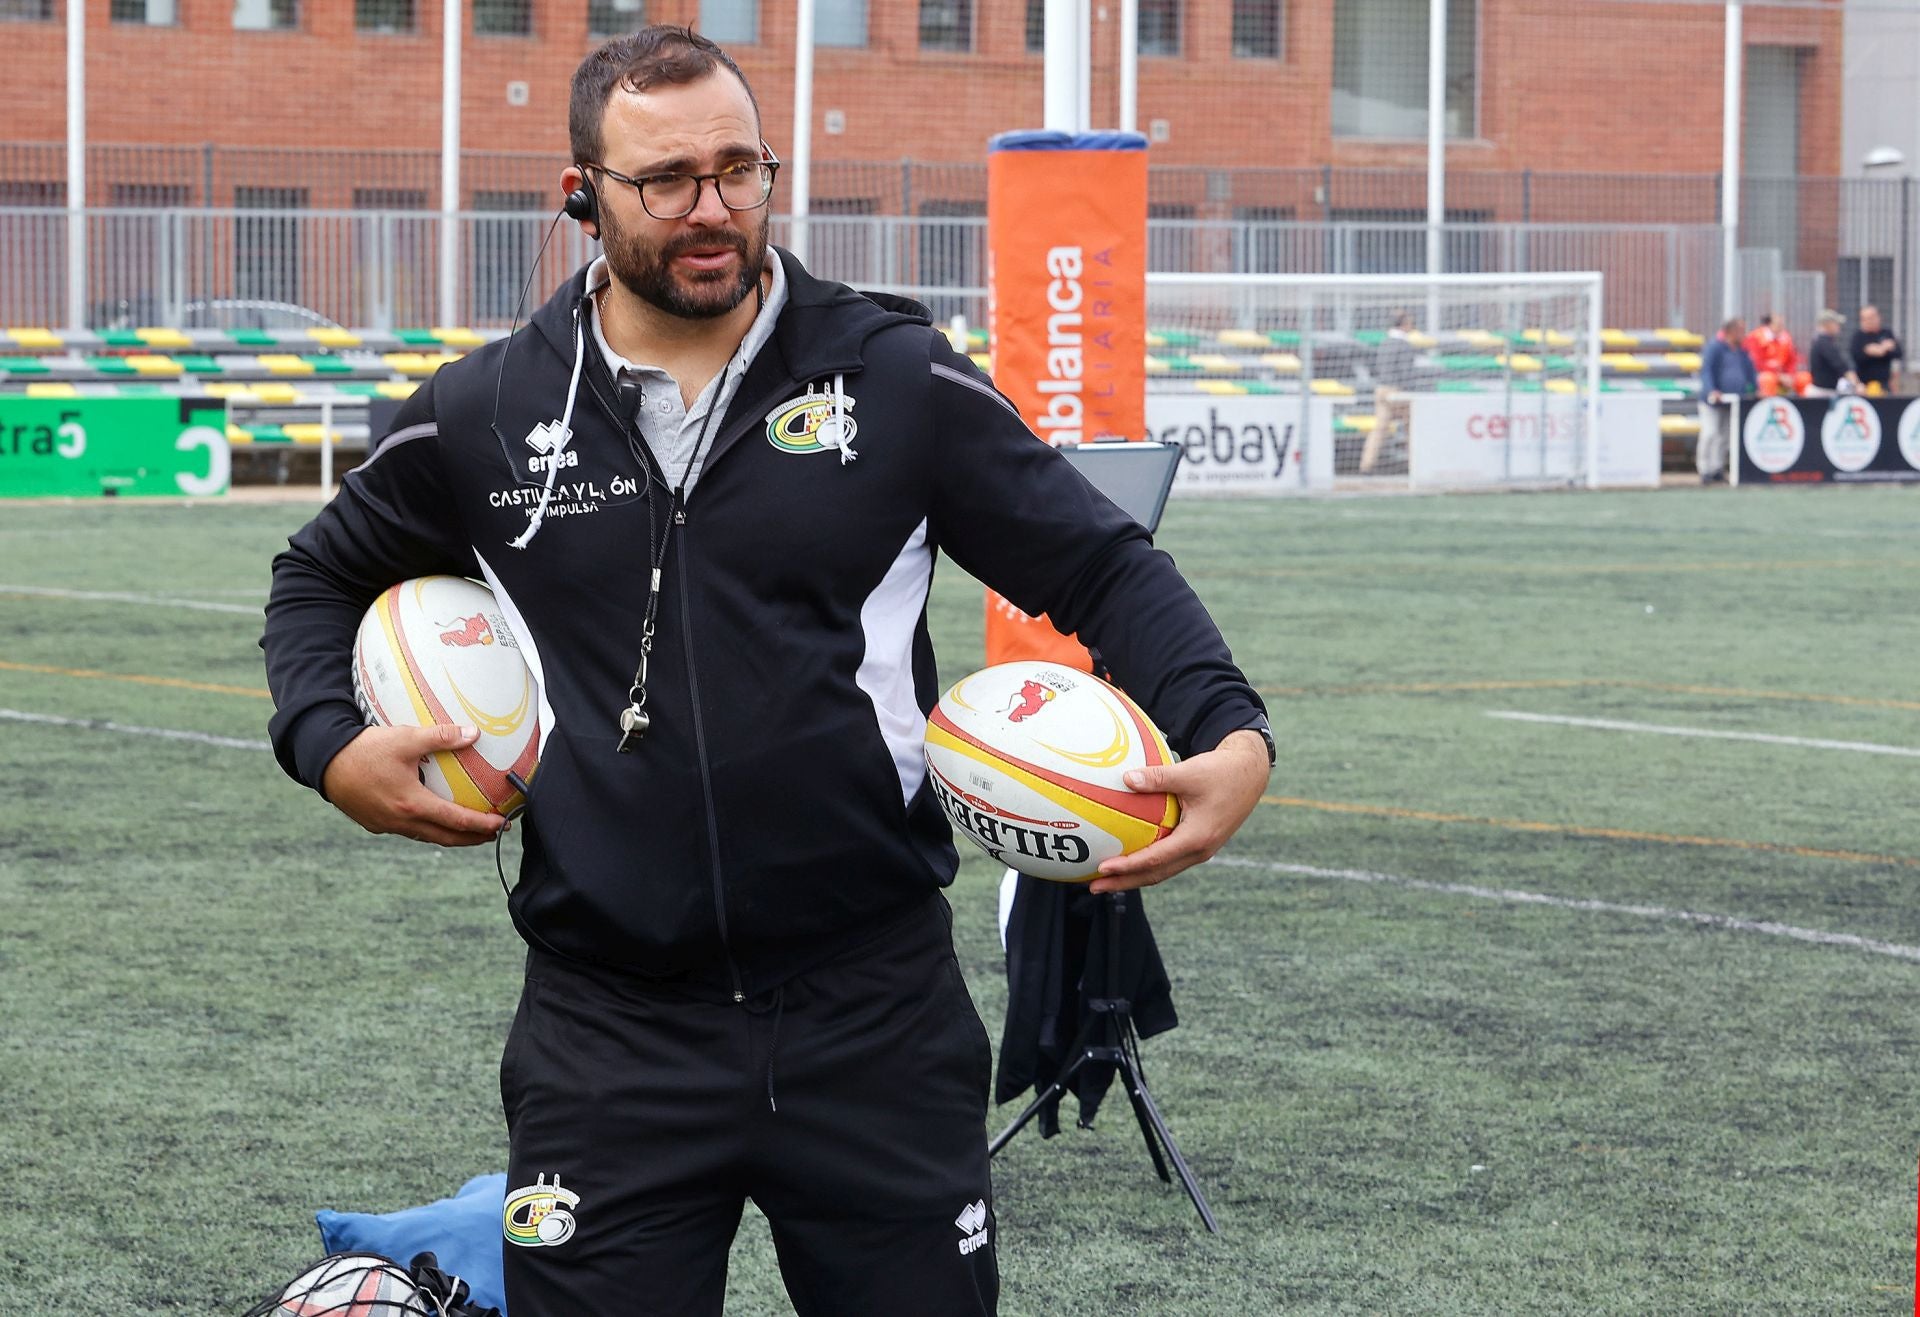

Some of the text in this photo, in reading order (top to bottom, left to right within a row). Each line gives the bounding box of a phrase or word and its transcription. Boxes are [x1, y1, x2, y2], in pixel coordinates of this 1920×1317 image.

[489, 475, 637, 507] CASTILLA Y LÓN
[546, 501, 599, 518] IMPULSA
[926, 764, 1090, 864] GILBER
